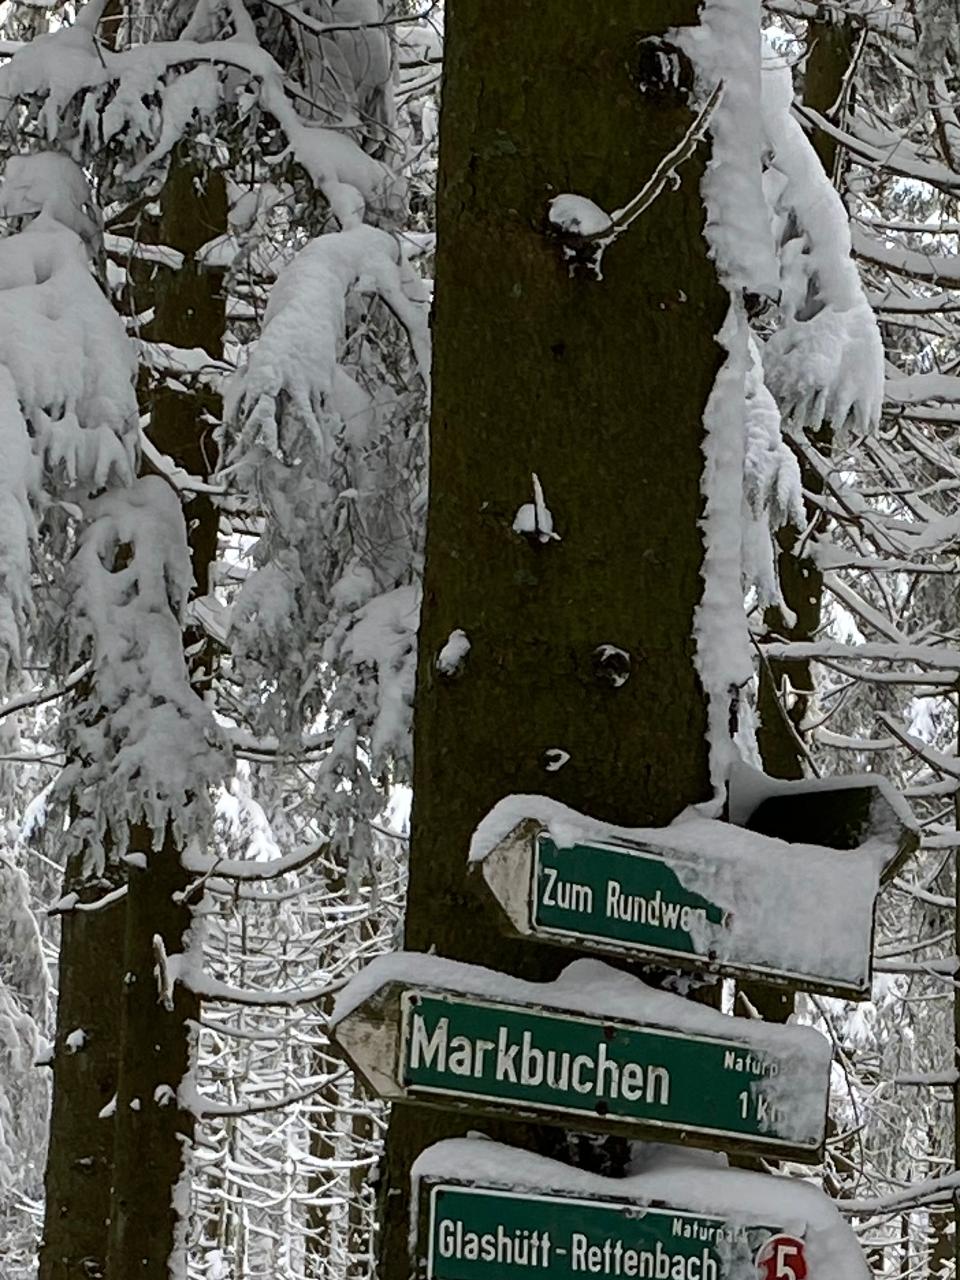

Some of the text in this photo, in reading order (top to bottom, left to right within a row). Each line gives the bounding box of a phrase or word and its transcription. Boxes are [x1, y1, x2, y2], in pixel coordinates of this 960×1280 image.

[542, 868, 594, 914] Zum
[410, 1013, 670, 1106] Markbuchen
[723, 1050, 779, 1080] Naturp
[739, 1090, 748, 1119] 1
